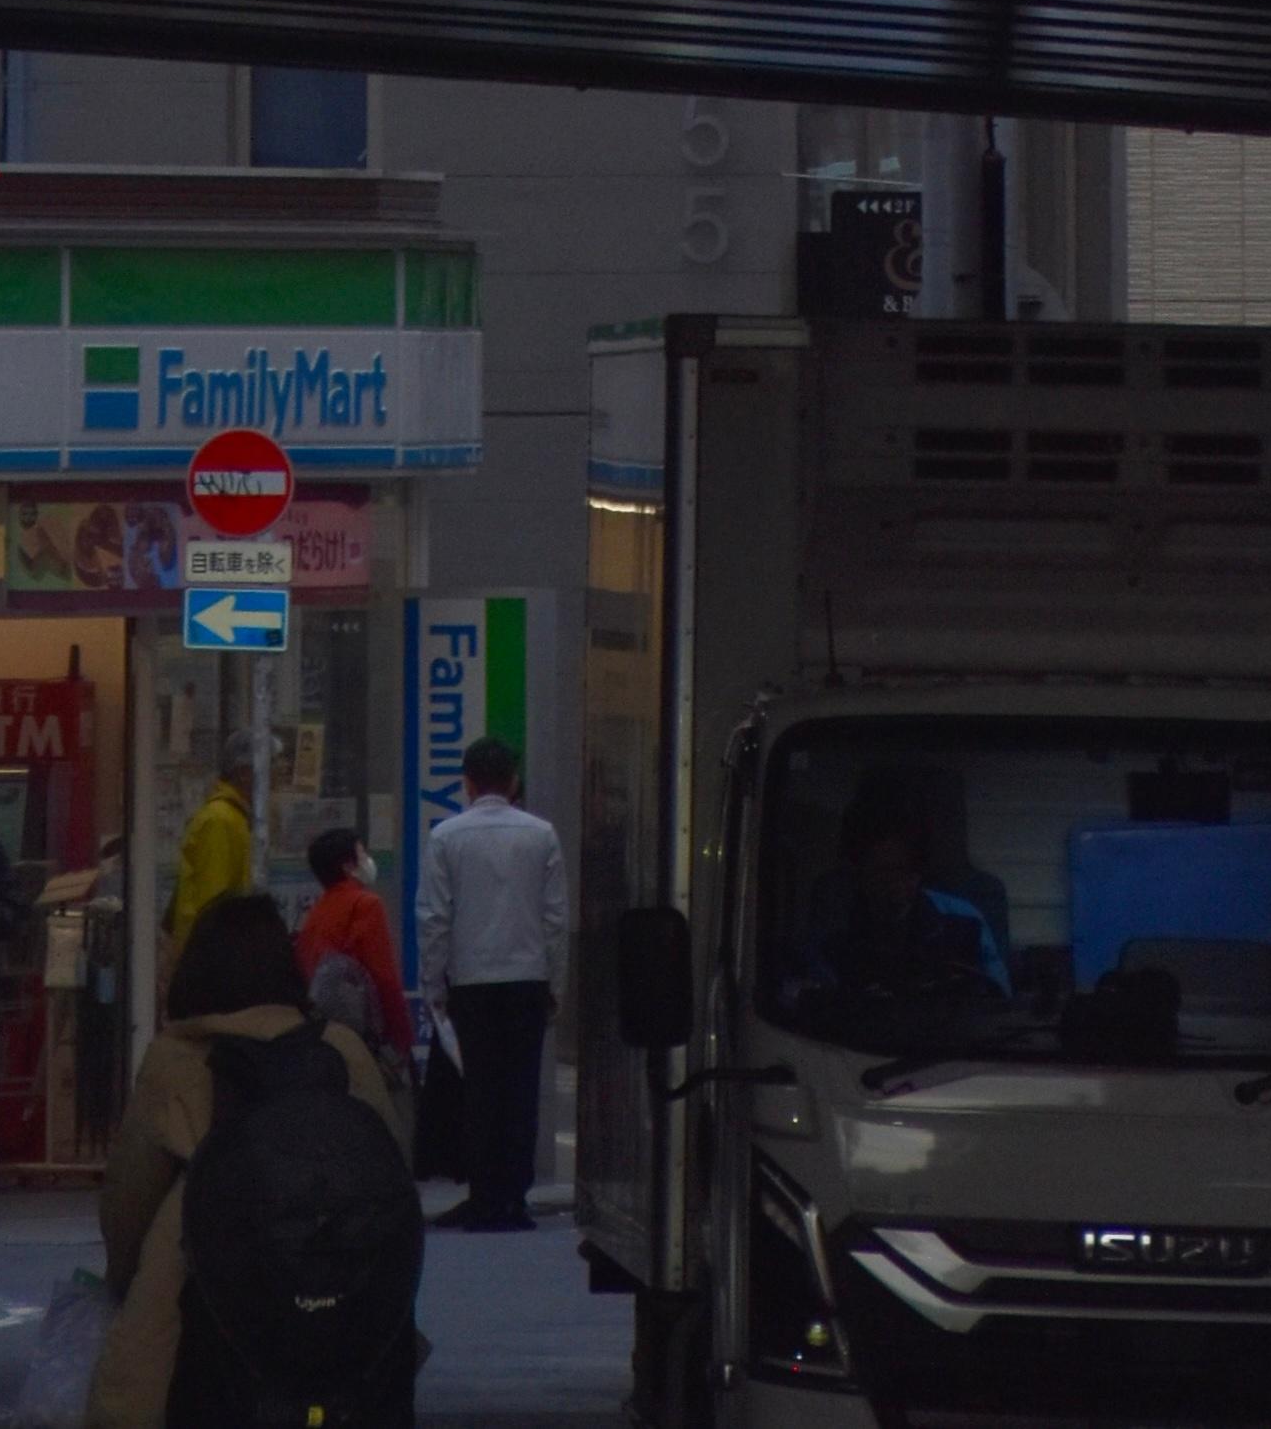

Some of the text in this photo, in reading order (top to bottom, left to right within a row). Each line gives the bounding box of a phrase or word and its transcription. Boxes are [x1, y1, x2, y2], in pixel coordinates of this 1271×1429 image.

[158, 348, 388, 435] FamilyMart
[191, 551, 286, 575] 自転車を除く
[421, 623, 477, 829] Family
[1083, 1230, 1256, 1266] ISUZU
